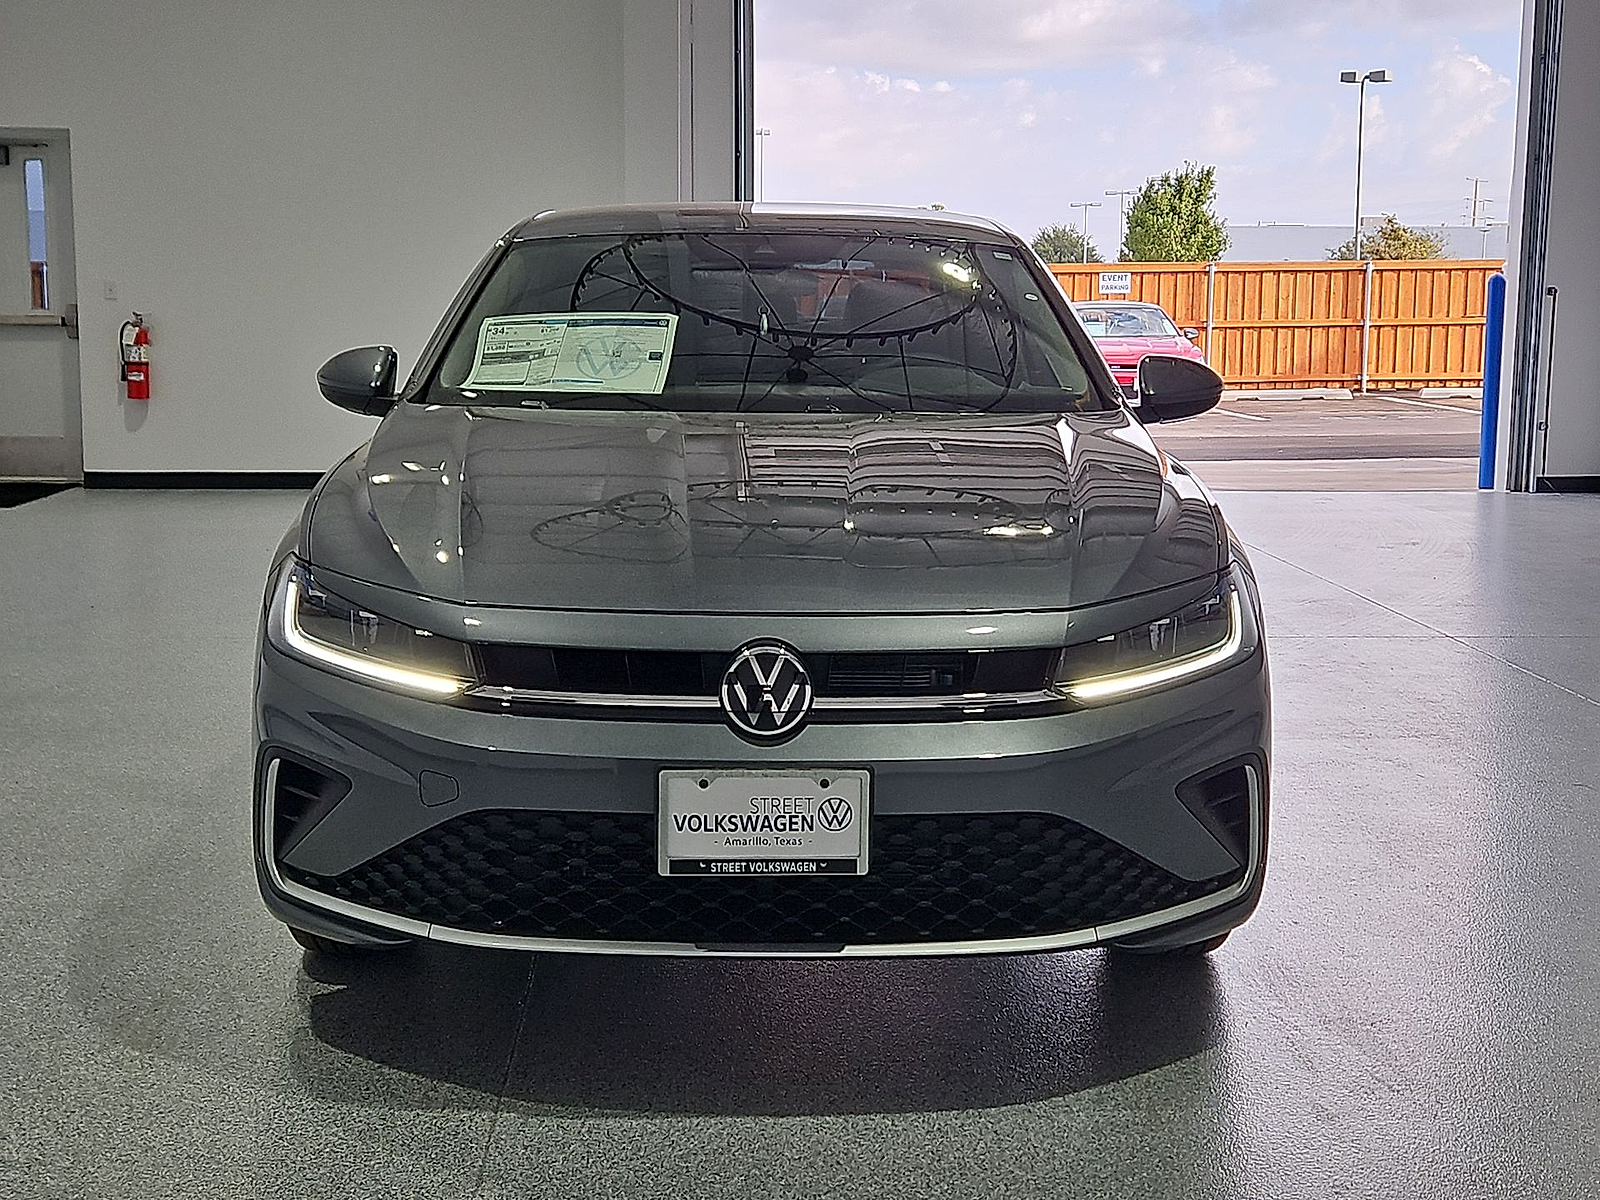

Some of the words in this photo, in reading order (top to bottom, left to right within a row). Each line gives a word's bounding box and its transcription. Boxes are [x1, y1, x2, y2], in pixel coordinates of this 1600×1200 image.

[1102, 274, 1128, 282] EVENT
[492, 327, 505, 335] 34
[750, 797, 814, 815] STREET
[673, 814, 815, 833] VOLKSWAGEN
[724, 836, 772, 847] Amarillo,
[774, 836, 803, 846] Texas
[710, 862, 746, 873] STREET
[749, 862, 817, 873] VOLKSWAGEN
